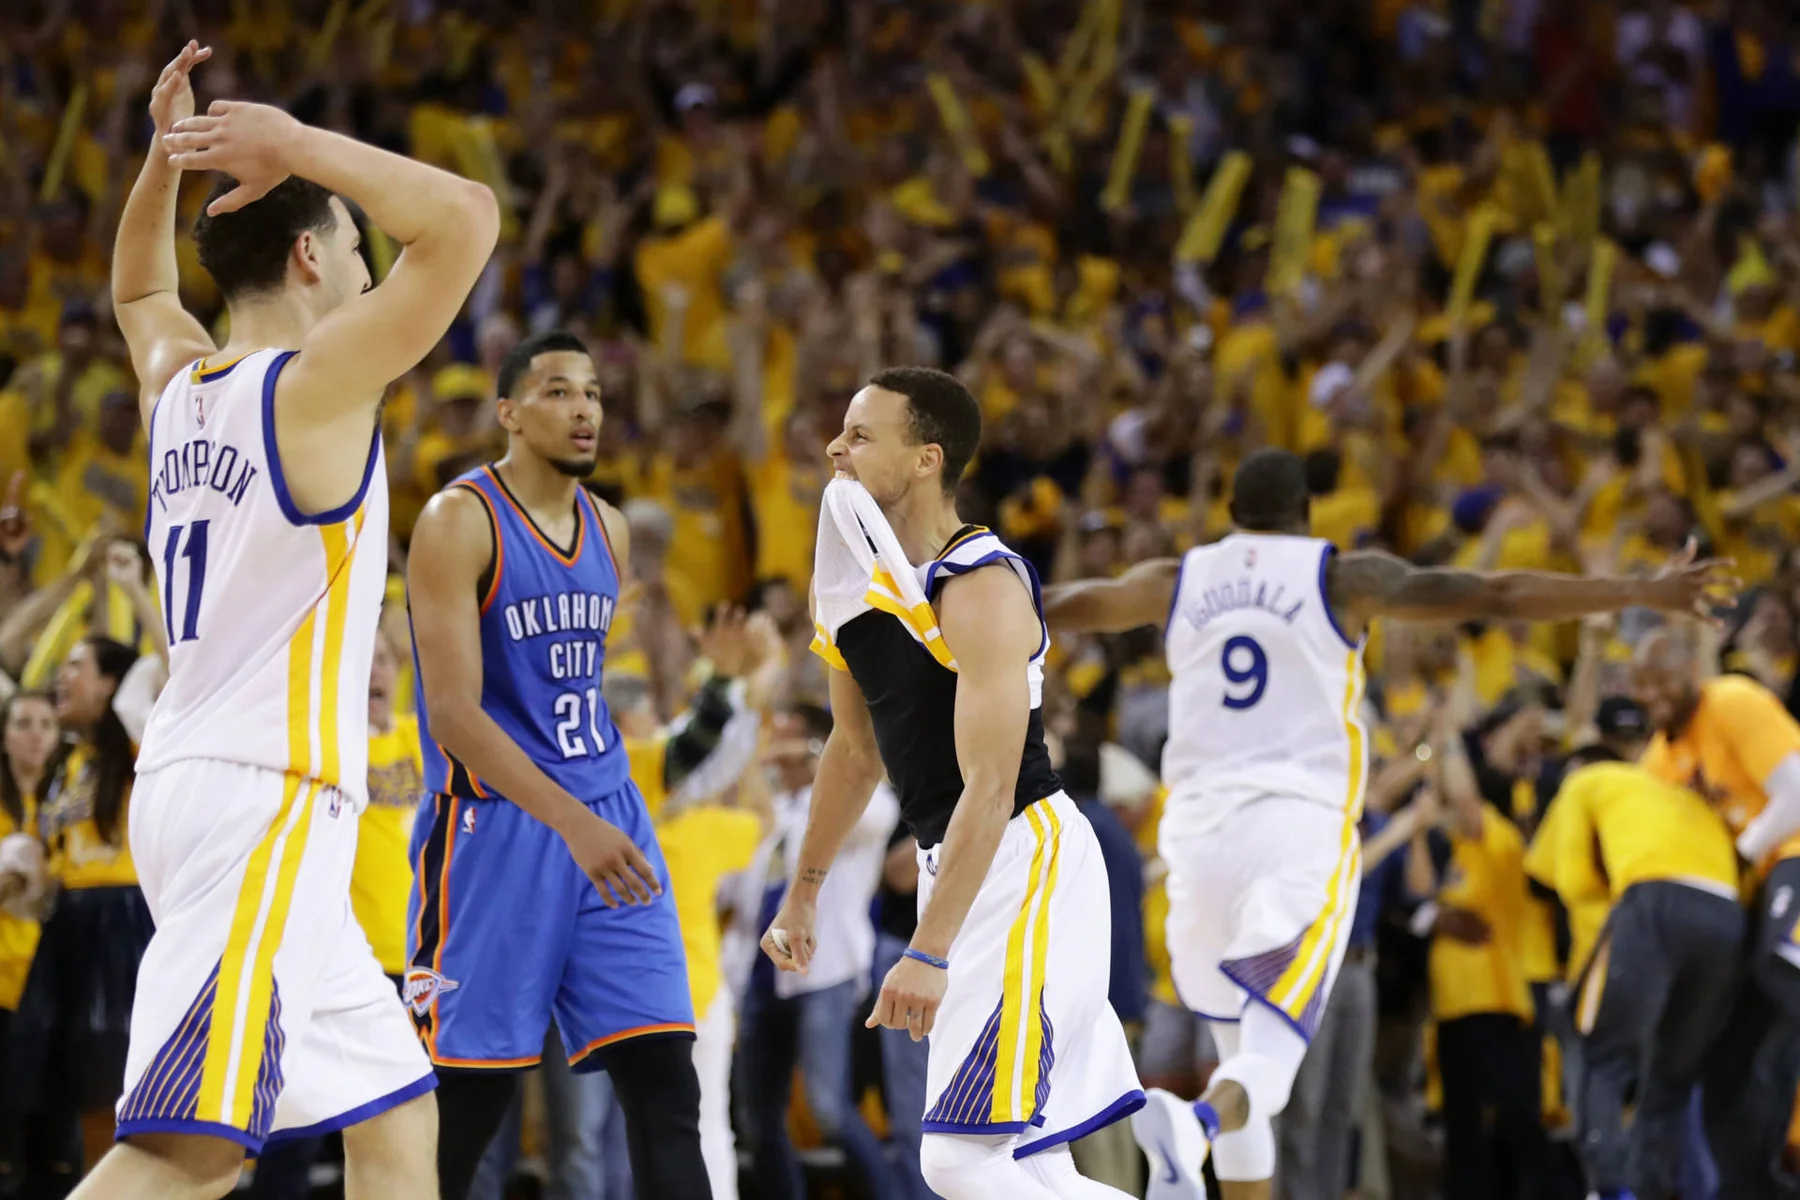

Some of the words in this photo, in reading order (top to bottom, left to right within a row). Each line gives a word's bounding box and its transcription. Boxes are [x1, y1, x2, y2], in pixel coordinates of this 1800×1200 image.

[152, 439, 258, 513] TOMPON
[163, 519, 211, 646] 11
[504, 593, 613, 641] OKLAHOM
[549, 640, 597, 679] CITY
[1221, 635, 1268, 710] 9
[554, 687, 606, 759] 21
